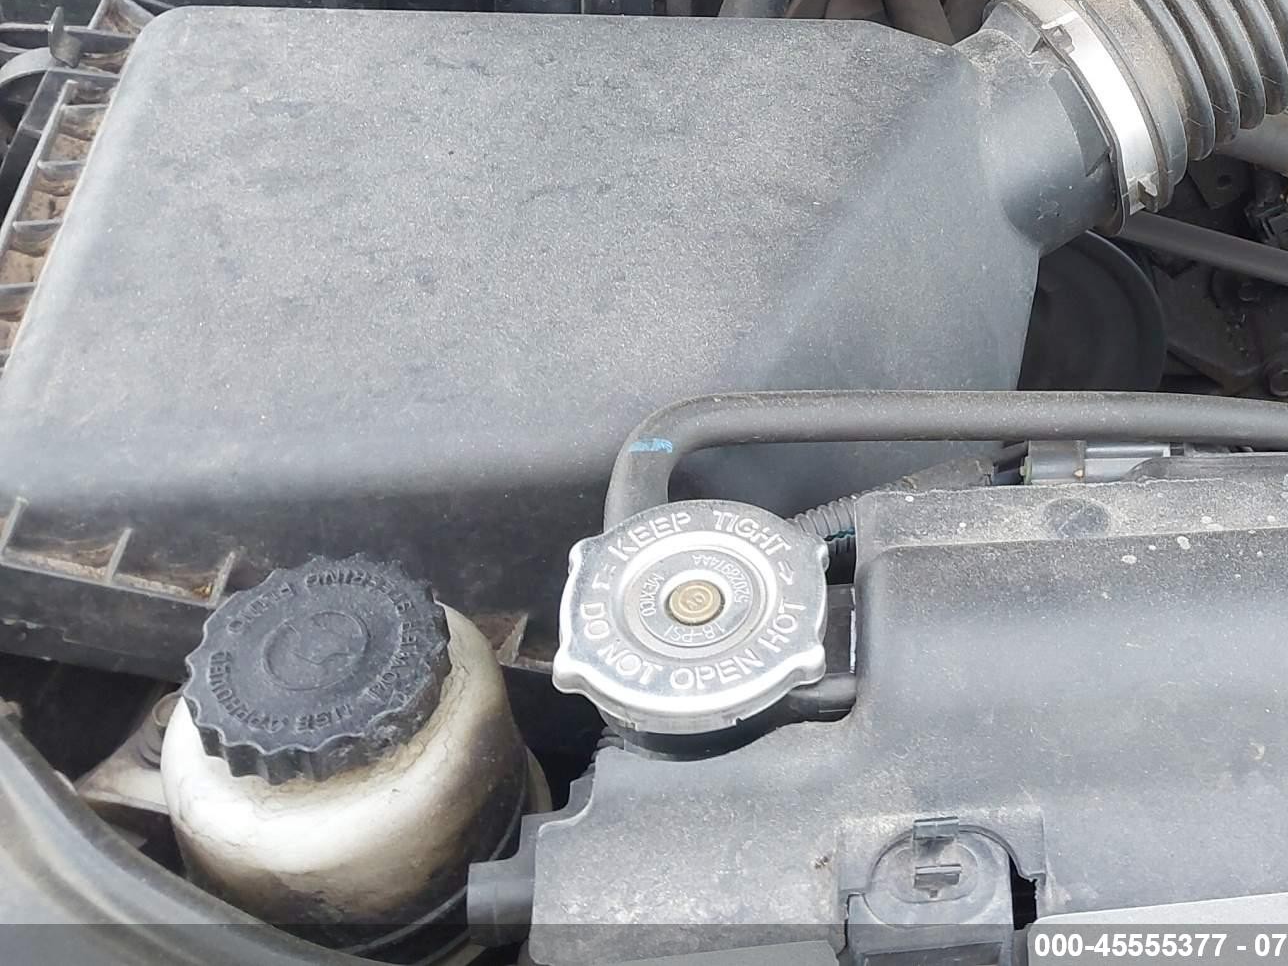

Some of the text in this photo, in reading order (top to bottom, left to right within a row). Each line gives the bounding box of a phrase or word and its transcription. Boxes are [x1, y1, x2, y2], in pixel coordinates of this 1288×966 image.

[607, 510, 792, 561] KEEP TIGHT
[640, 572, 665, 617] MEXICO
[581, 598, 806, 689] DO NOT OPEN HOT
